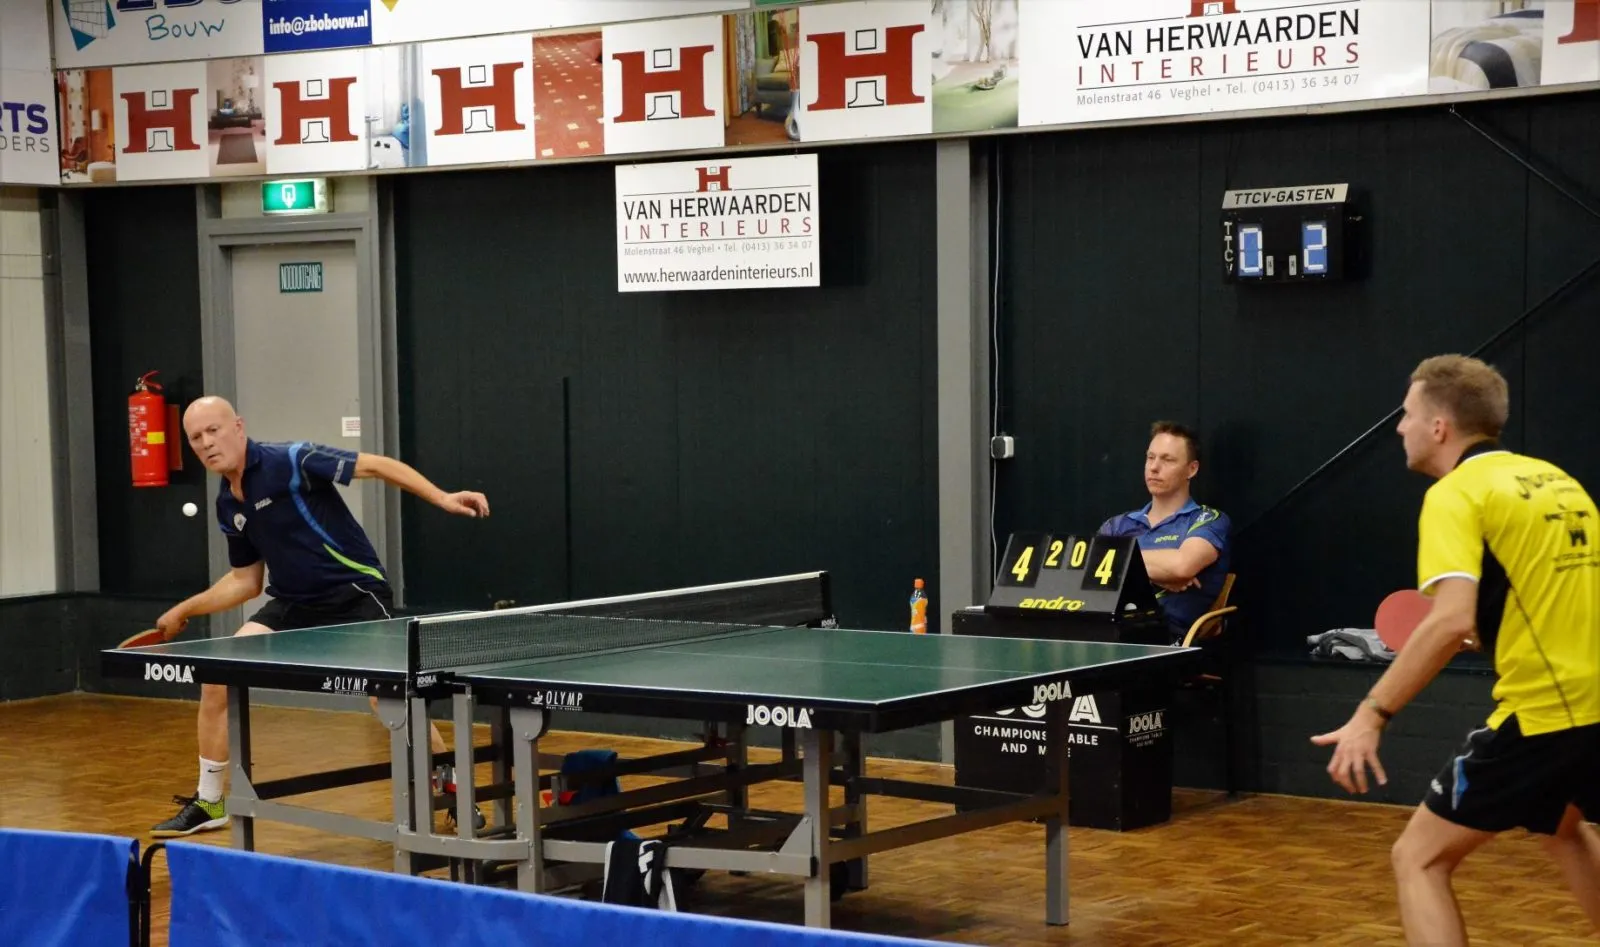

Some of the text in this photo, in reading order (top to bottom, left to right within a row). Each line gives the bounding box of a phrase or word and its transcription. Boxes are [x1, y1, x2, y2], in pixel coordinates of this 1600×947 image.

[269, 9, 368, 36] info@zbobouw.nl
[1077, 30, 1132, 59] VAN
[1146, 9, 1359, 53] HERWAARDEN
[1078, 42, 1359, 85] INTERIEURS
[1077, 73, 1359, 105] Molenstraat 46 Veghel Tel. (0413) 36 34 07
[624, 192, 811, 220] VAN HERWAARDEN
[1235, 188, 1335, 205] TTCV-GASTEN
[625, 217, 811, 240] INTERIEURS
[624, 247, 671, 256] Molenstraat
[674, 246, 684, 254] 46
[687, 243, 714, 255] Veghel
[1240, 224, 1327, 273] 0 2
[624, 262, 813, 283] www.herwaardeninterieurs.nl
[1011, 540, 1116, 585] 4 2 0 4
[1019, 596, 1084, 612] andro
[144, 663, 193, 683] JOOLA
[335, 676, 368, 691] OLYMP
[546, 690, 583, 706] OLYMP
[1032, 680, 1072, 704] JOOLA
[746, 704, 812, 729] JOOLA
[1130, 712, 1161, 734] JOOLA
[1001, 742, 1028, 754] AND
[1068, 733, 1099, 746] ABLE
